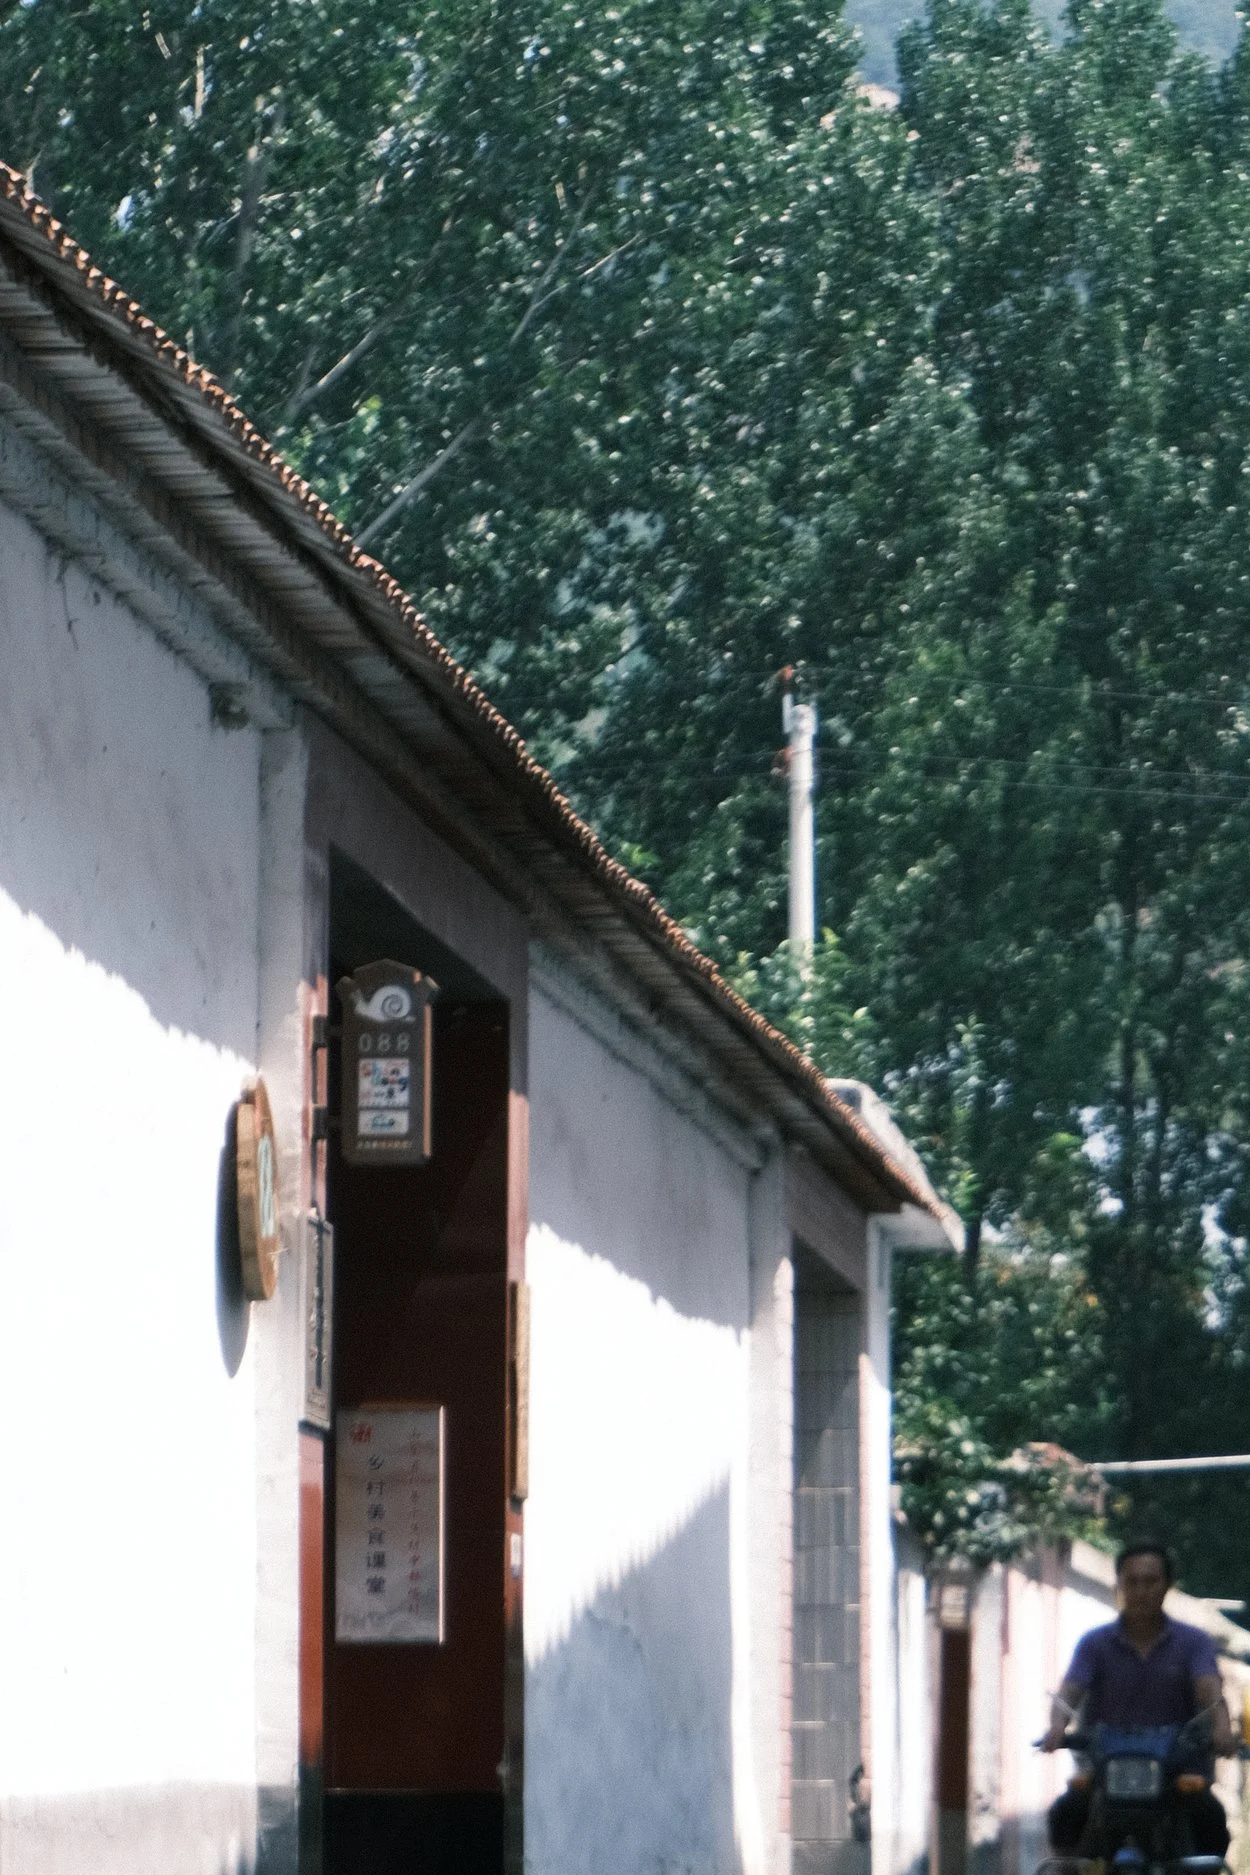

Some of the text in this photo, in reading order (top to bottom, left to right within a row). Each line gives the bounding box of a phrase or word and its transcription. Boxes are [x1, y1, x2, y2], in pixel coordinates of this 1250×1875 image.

[359, 1032, 411, 1052] 088
[366, 1454, 386, 1596] 乡村美食课堂
